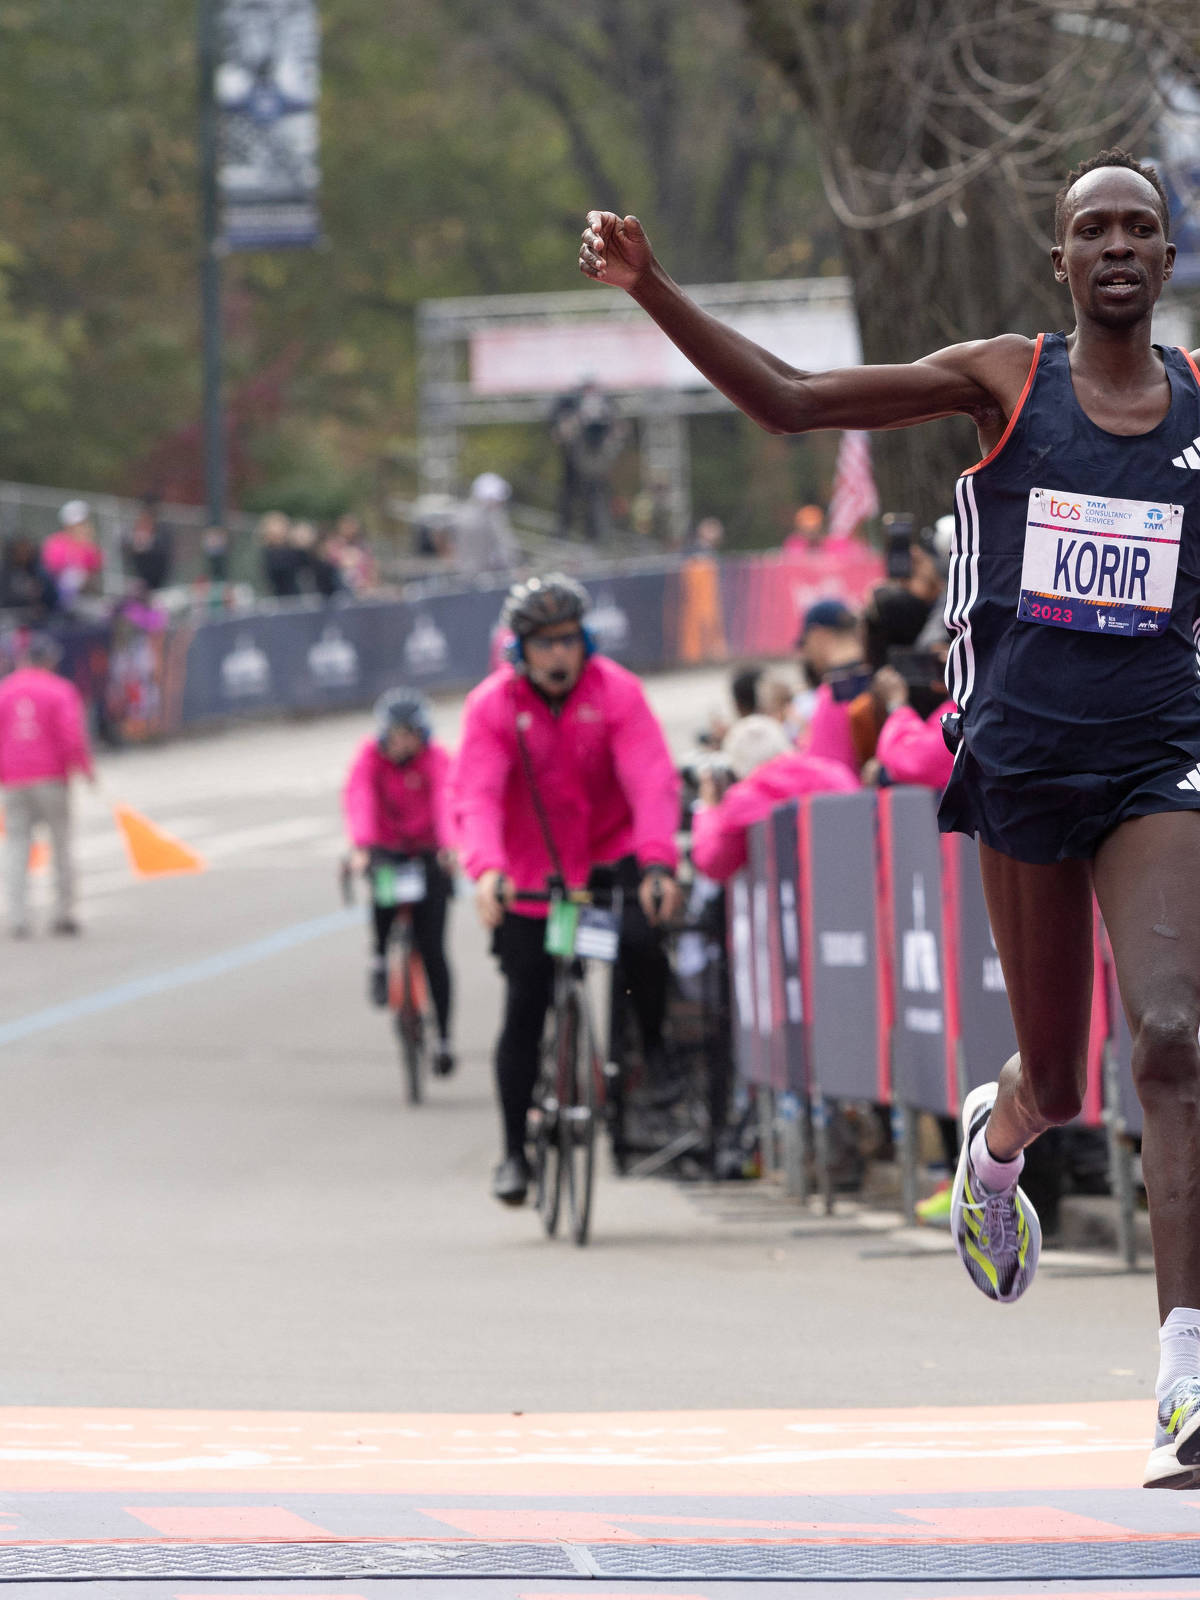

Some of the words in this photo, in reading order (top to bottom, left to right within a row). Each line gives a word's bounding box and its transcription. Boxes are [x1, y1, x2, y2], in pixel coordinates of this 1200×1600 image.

[1050, 496, 1081, 520] tcs
[1086, 501, 1107, 509] TATA
[1085, 509, 1133, 520] CONSULTANCY
[1084, 516, 1115, 526] SERVICES
[1143, 522, 1164, 531] TATA
[1053, 537, 1150, 601] KORIR
[1031, 603, 1073, 623] 2023
